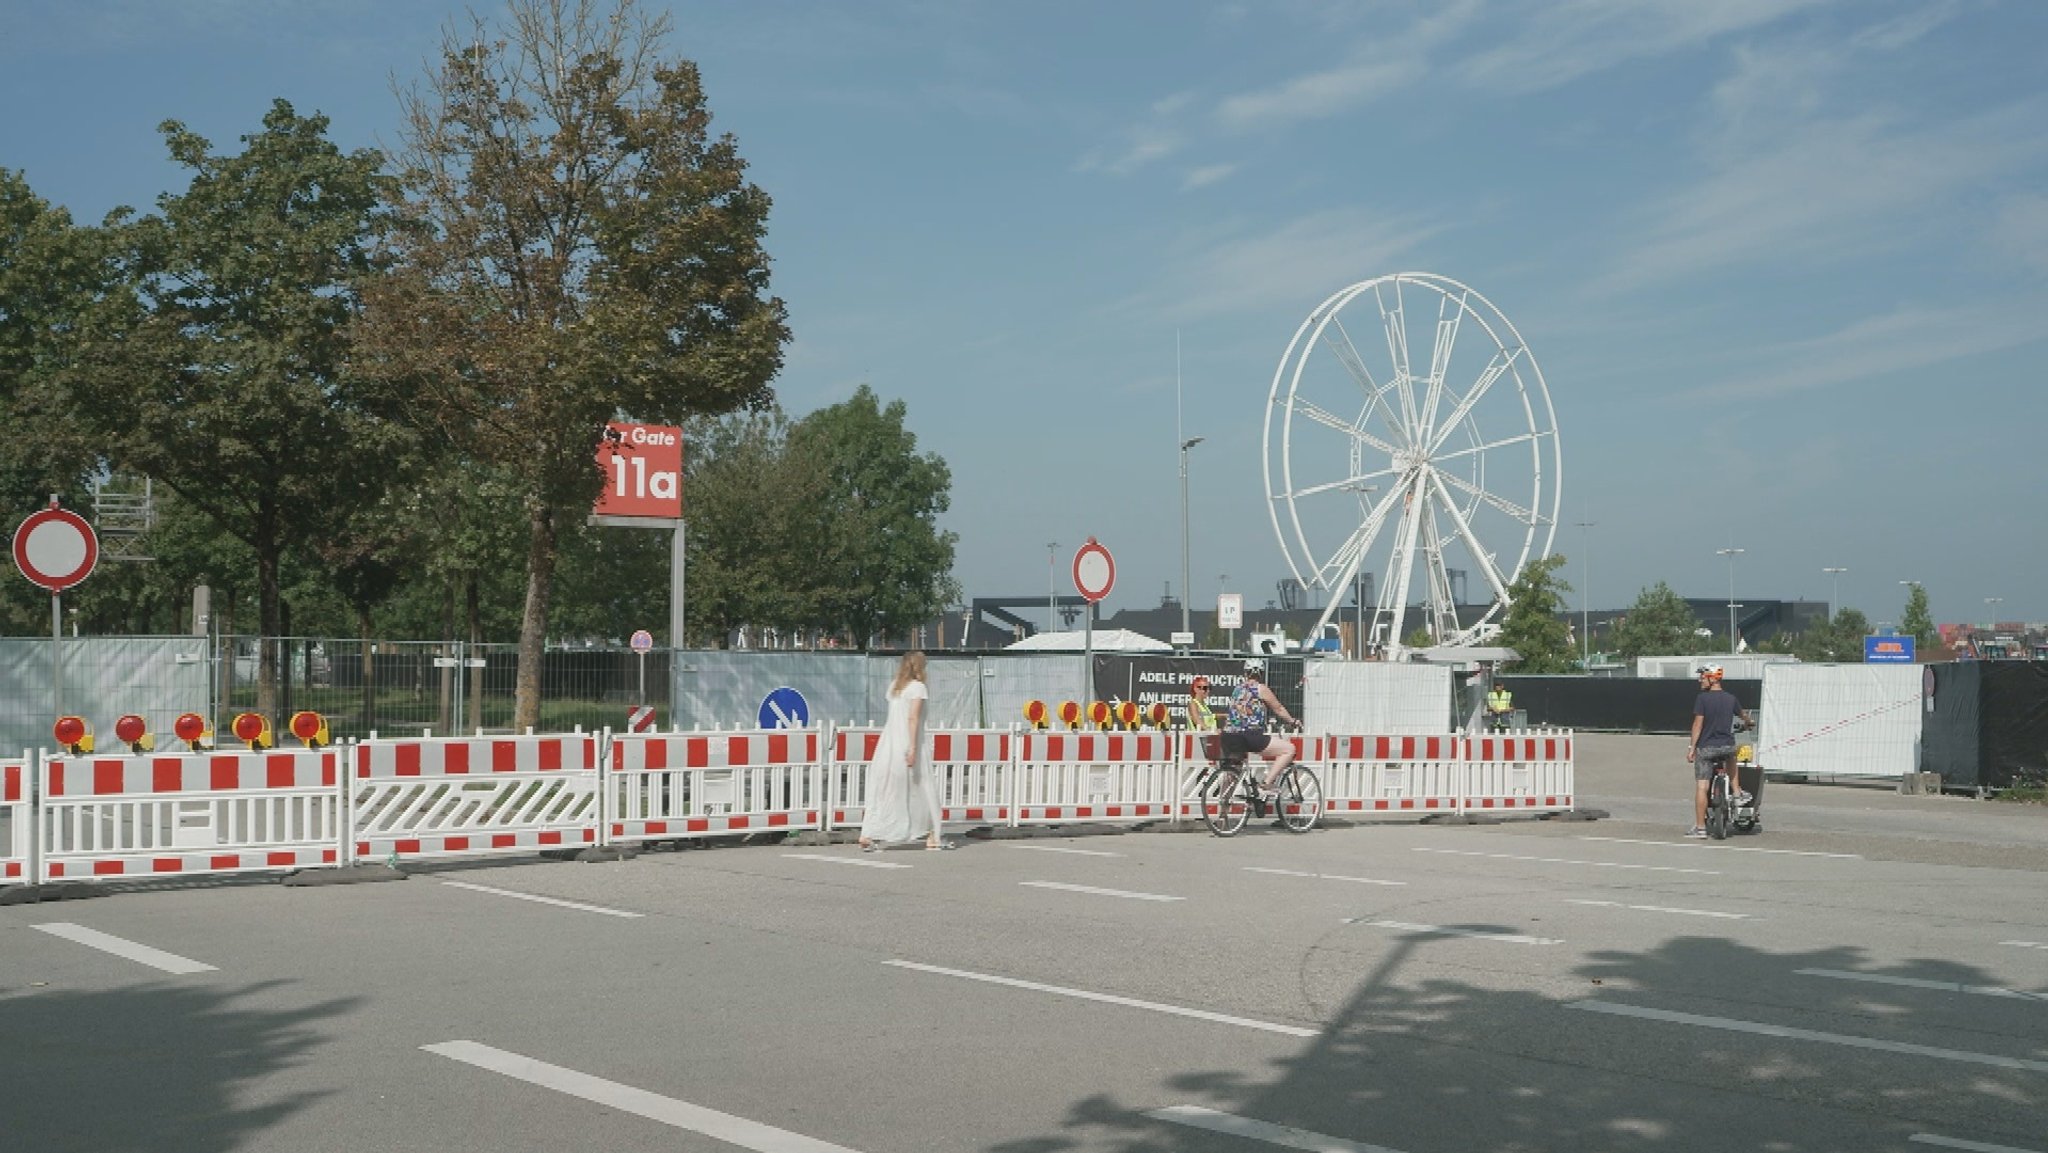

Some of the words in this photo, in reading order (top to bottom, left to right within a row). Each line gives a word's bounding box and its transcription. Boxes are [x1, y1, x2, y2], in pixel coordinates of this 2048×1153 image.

[631, 427, 675, 445] Gate
[612, 455, 677, 498] 11a
[1139, 672, 1176, 685] ADELE
[1139, 692, 1233, 705] ANLIEFERNGEN
